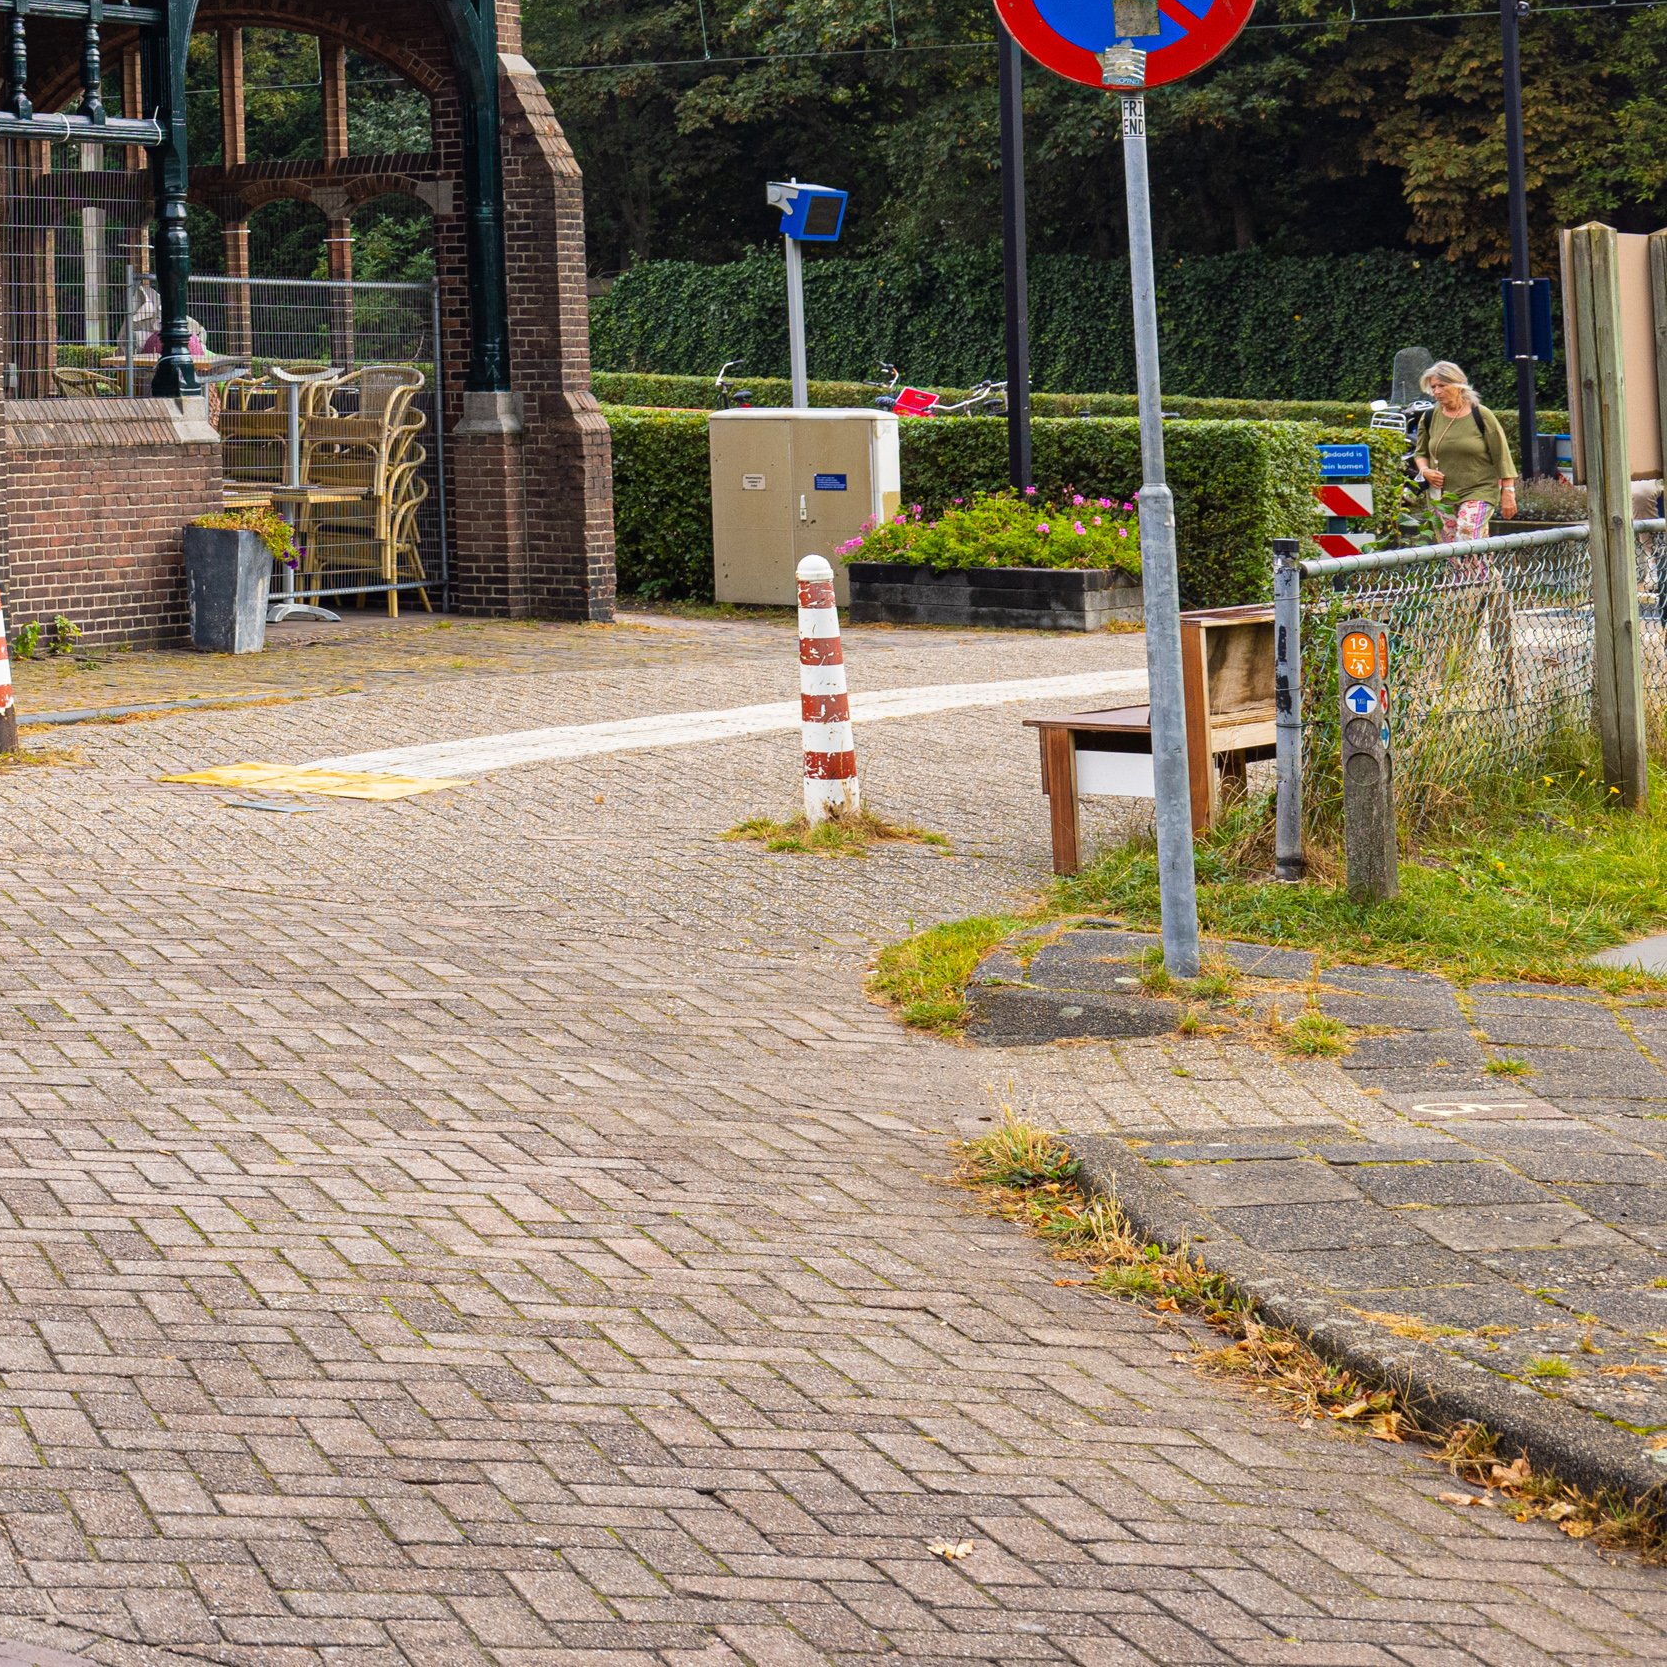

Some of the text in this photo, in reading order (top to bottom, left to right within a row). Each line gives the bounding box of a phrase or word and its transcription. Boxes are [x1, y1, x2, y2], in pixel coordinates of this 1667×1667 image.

[1123, 100, 1143, 117] FRI
[1124, 118, 1144, 135] END
[1350, 637, 1368, 651] 19
